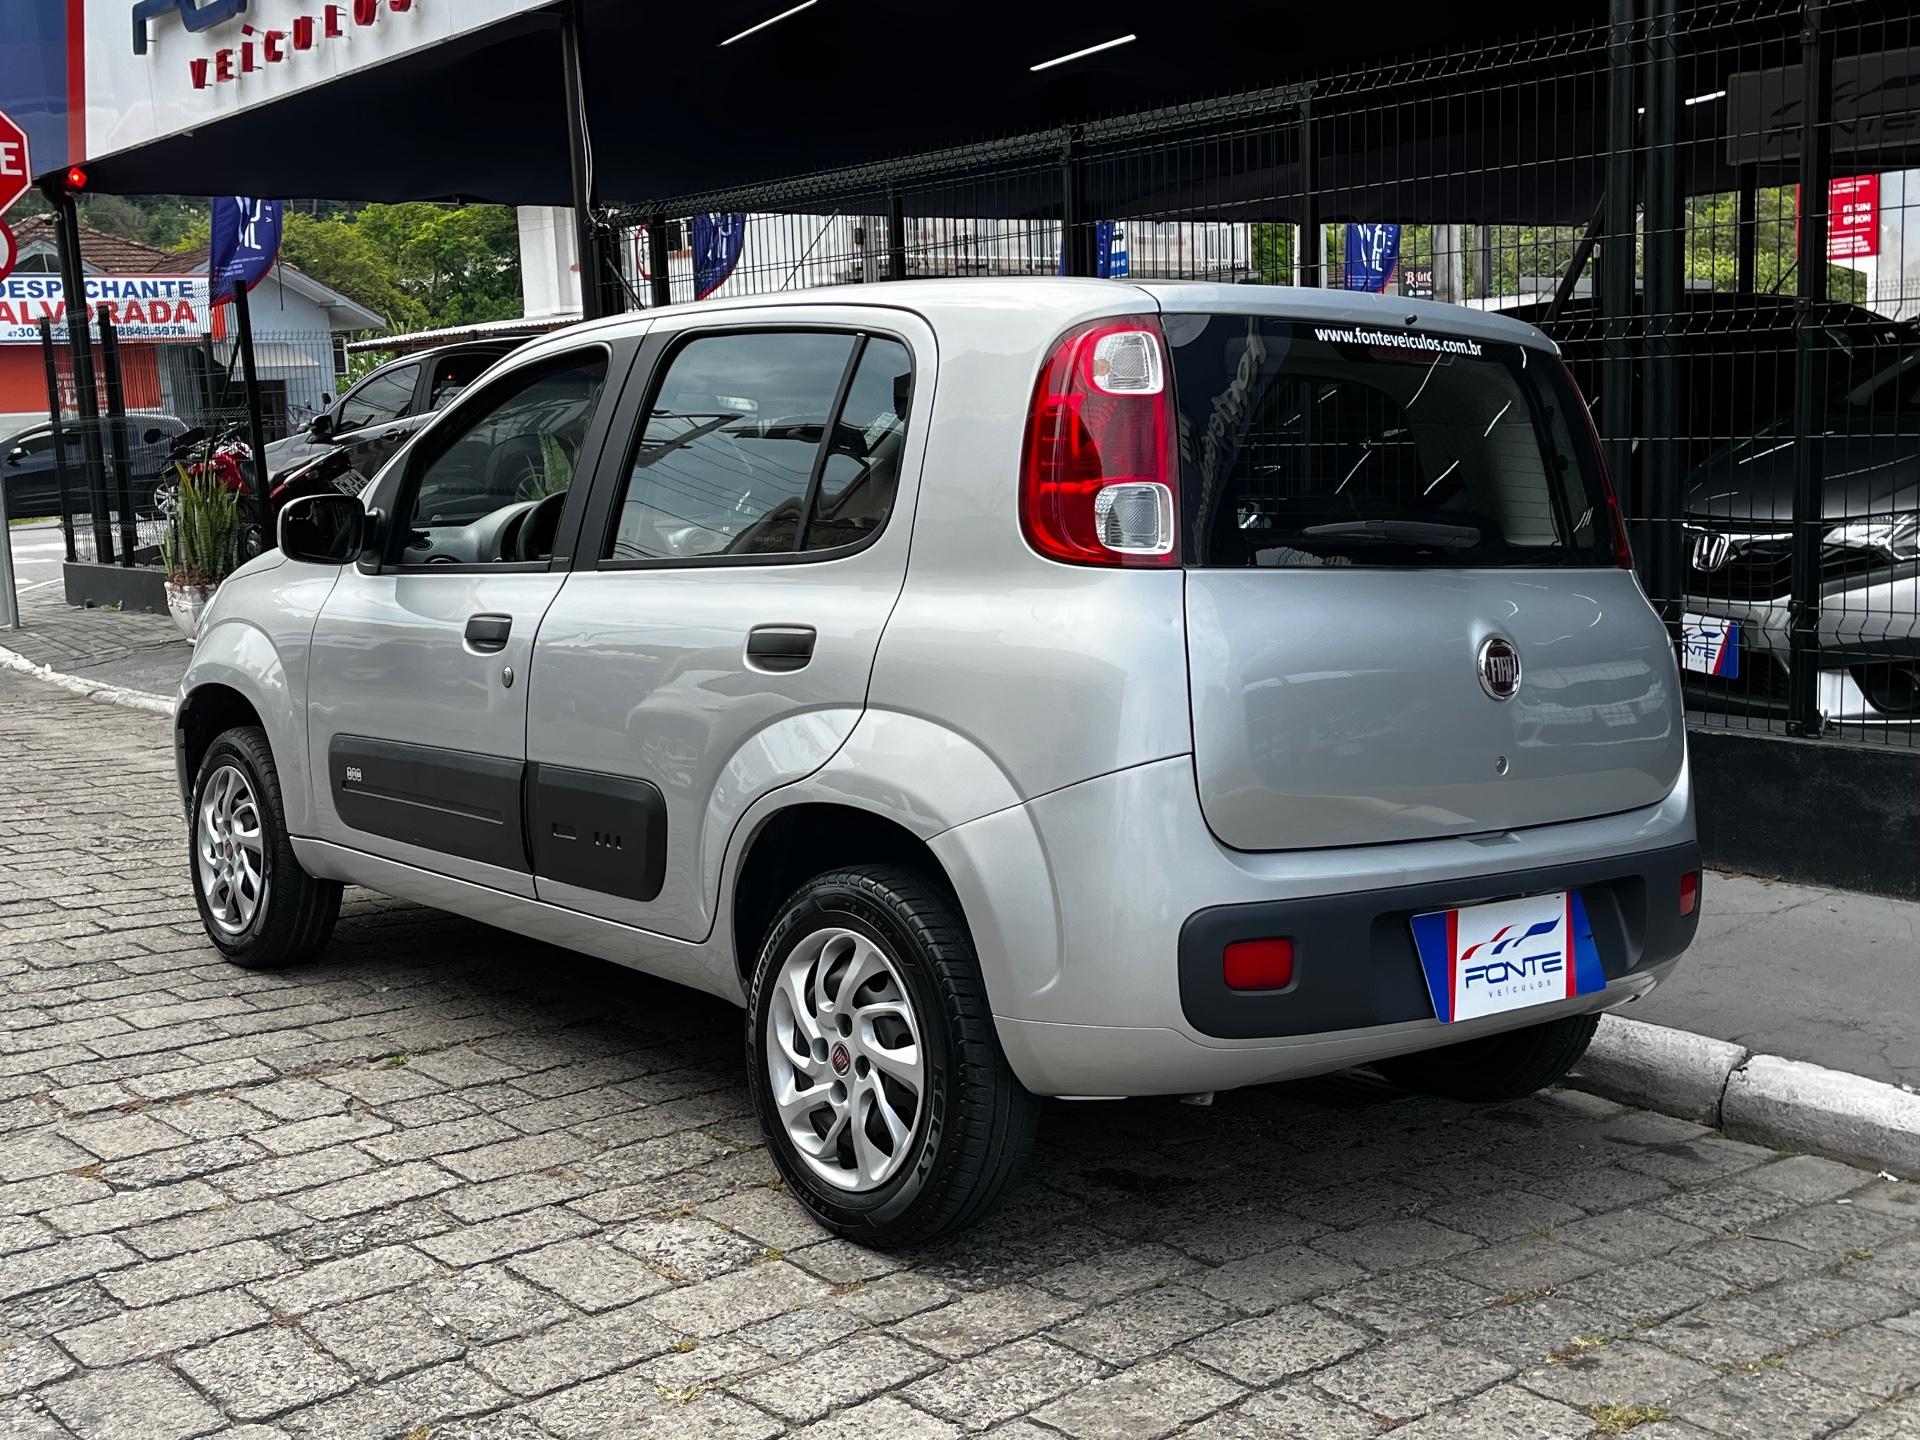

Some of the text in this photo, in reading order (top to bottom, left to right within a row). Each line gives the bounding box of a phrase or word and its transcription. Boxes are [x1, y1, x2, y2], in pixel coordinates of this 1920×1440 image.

[0, 280, 193, 299] ESPCHANTE
[0, 300, 197, 325] ALVRADA
[1315, 327, 1482, 356] www.fonteveiculos.com.br
[1465, 951, 1563, 989] FONTE
